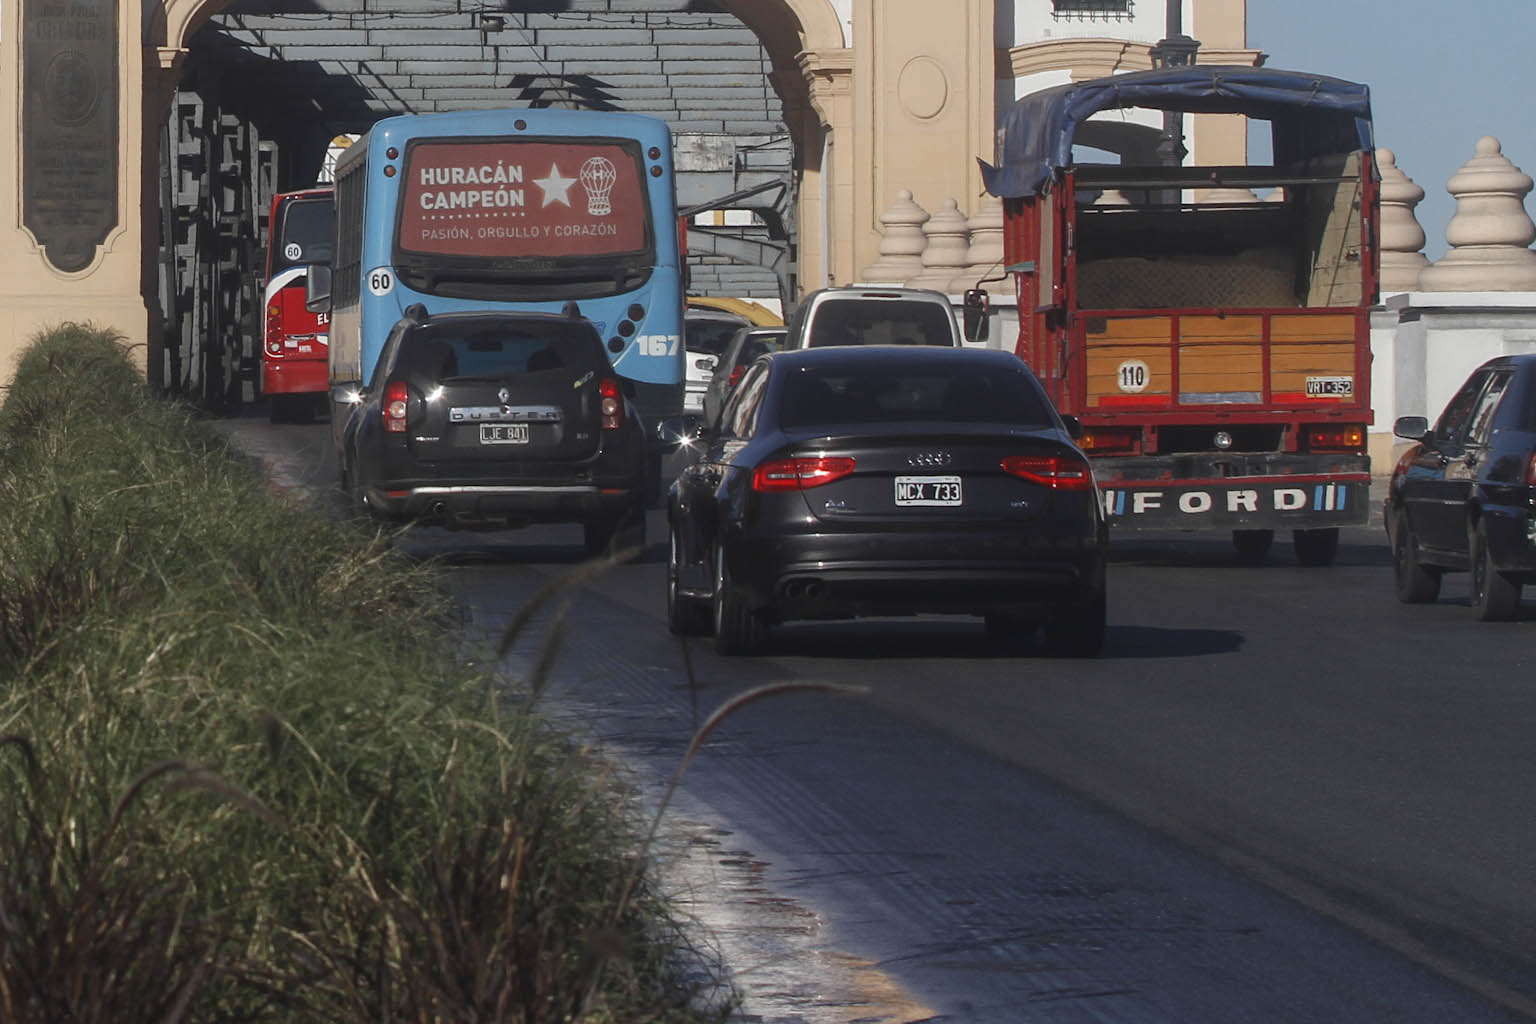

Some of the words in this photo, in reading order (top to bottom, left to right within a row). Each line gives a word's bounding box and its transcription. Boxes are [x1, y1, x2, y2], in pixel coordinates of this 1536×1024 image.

[420, 160, 524, 185] HURACÁN
[419, 185, 525, 210] CAMPEÓN
[421, 224, 474, 241] PASIÓN,
[477, 226, 540, 239] ORGULLO
[542, 226, 551, 237] Y
[554, 221, 617, 237] CORAZÓN
[287, 247, 300, 257] 60
[371, 273, 391, 291] 60
[636, 335, 681, 356] 167
[1121, 366, 1144, 386] 110
[1307, 381, 1326, 394] VRT
[1331, 381, 1352, 394] 352
[452, 410, 559, 421] DUSTER
[481, 426, 502, 440] LJE
[507, 426, 527, 440] 841
[897, 483, 924, 500] MCX
[933, 483, 960, 500] 733
[1132, 488, 1307, 514] FORD
